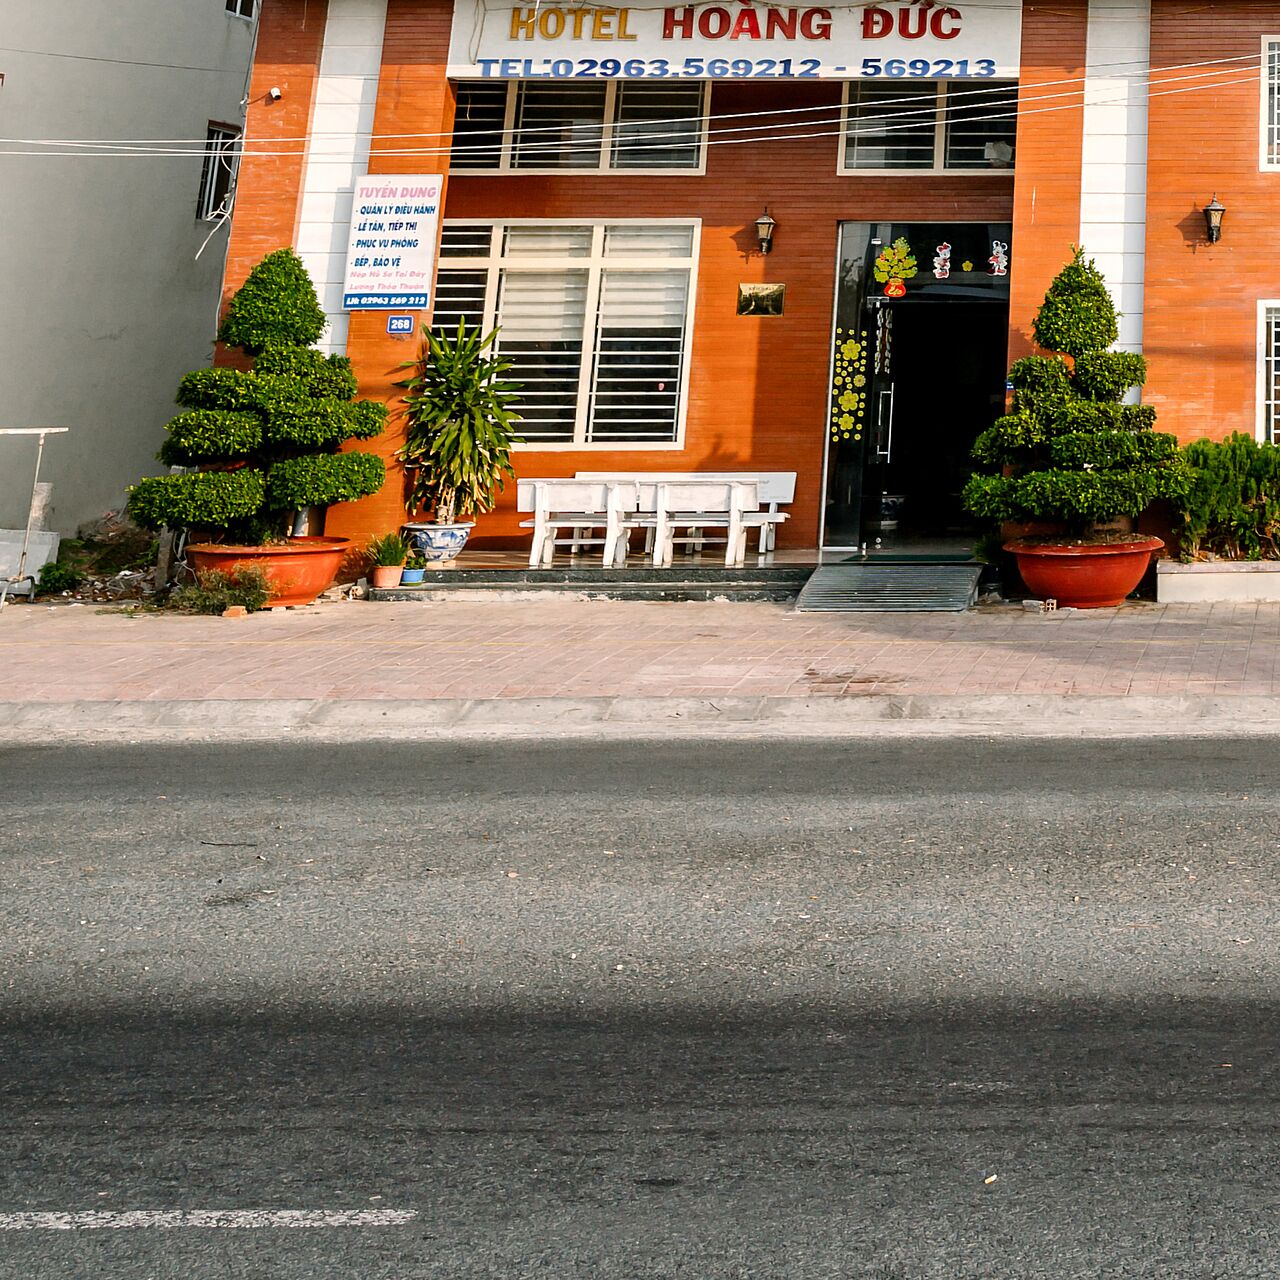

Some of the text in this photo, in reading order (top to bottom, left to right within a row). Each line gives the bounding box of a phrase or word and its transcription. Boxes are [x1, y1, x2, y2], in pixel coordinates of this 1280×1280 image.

[508, 7, 639, 41] HOTEL
[859, 57, 997, 78] 569213
[400, 187, 437, 201] DỤNG
[361, 296, 388, 305] 02963
[390, 296, 407, 305] 569
[408, 296, 426, 305] 212
[391, 319, 411, 330] 268
